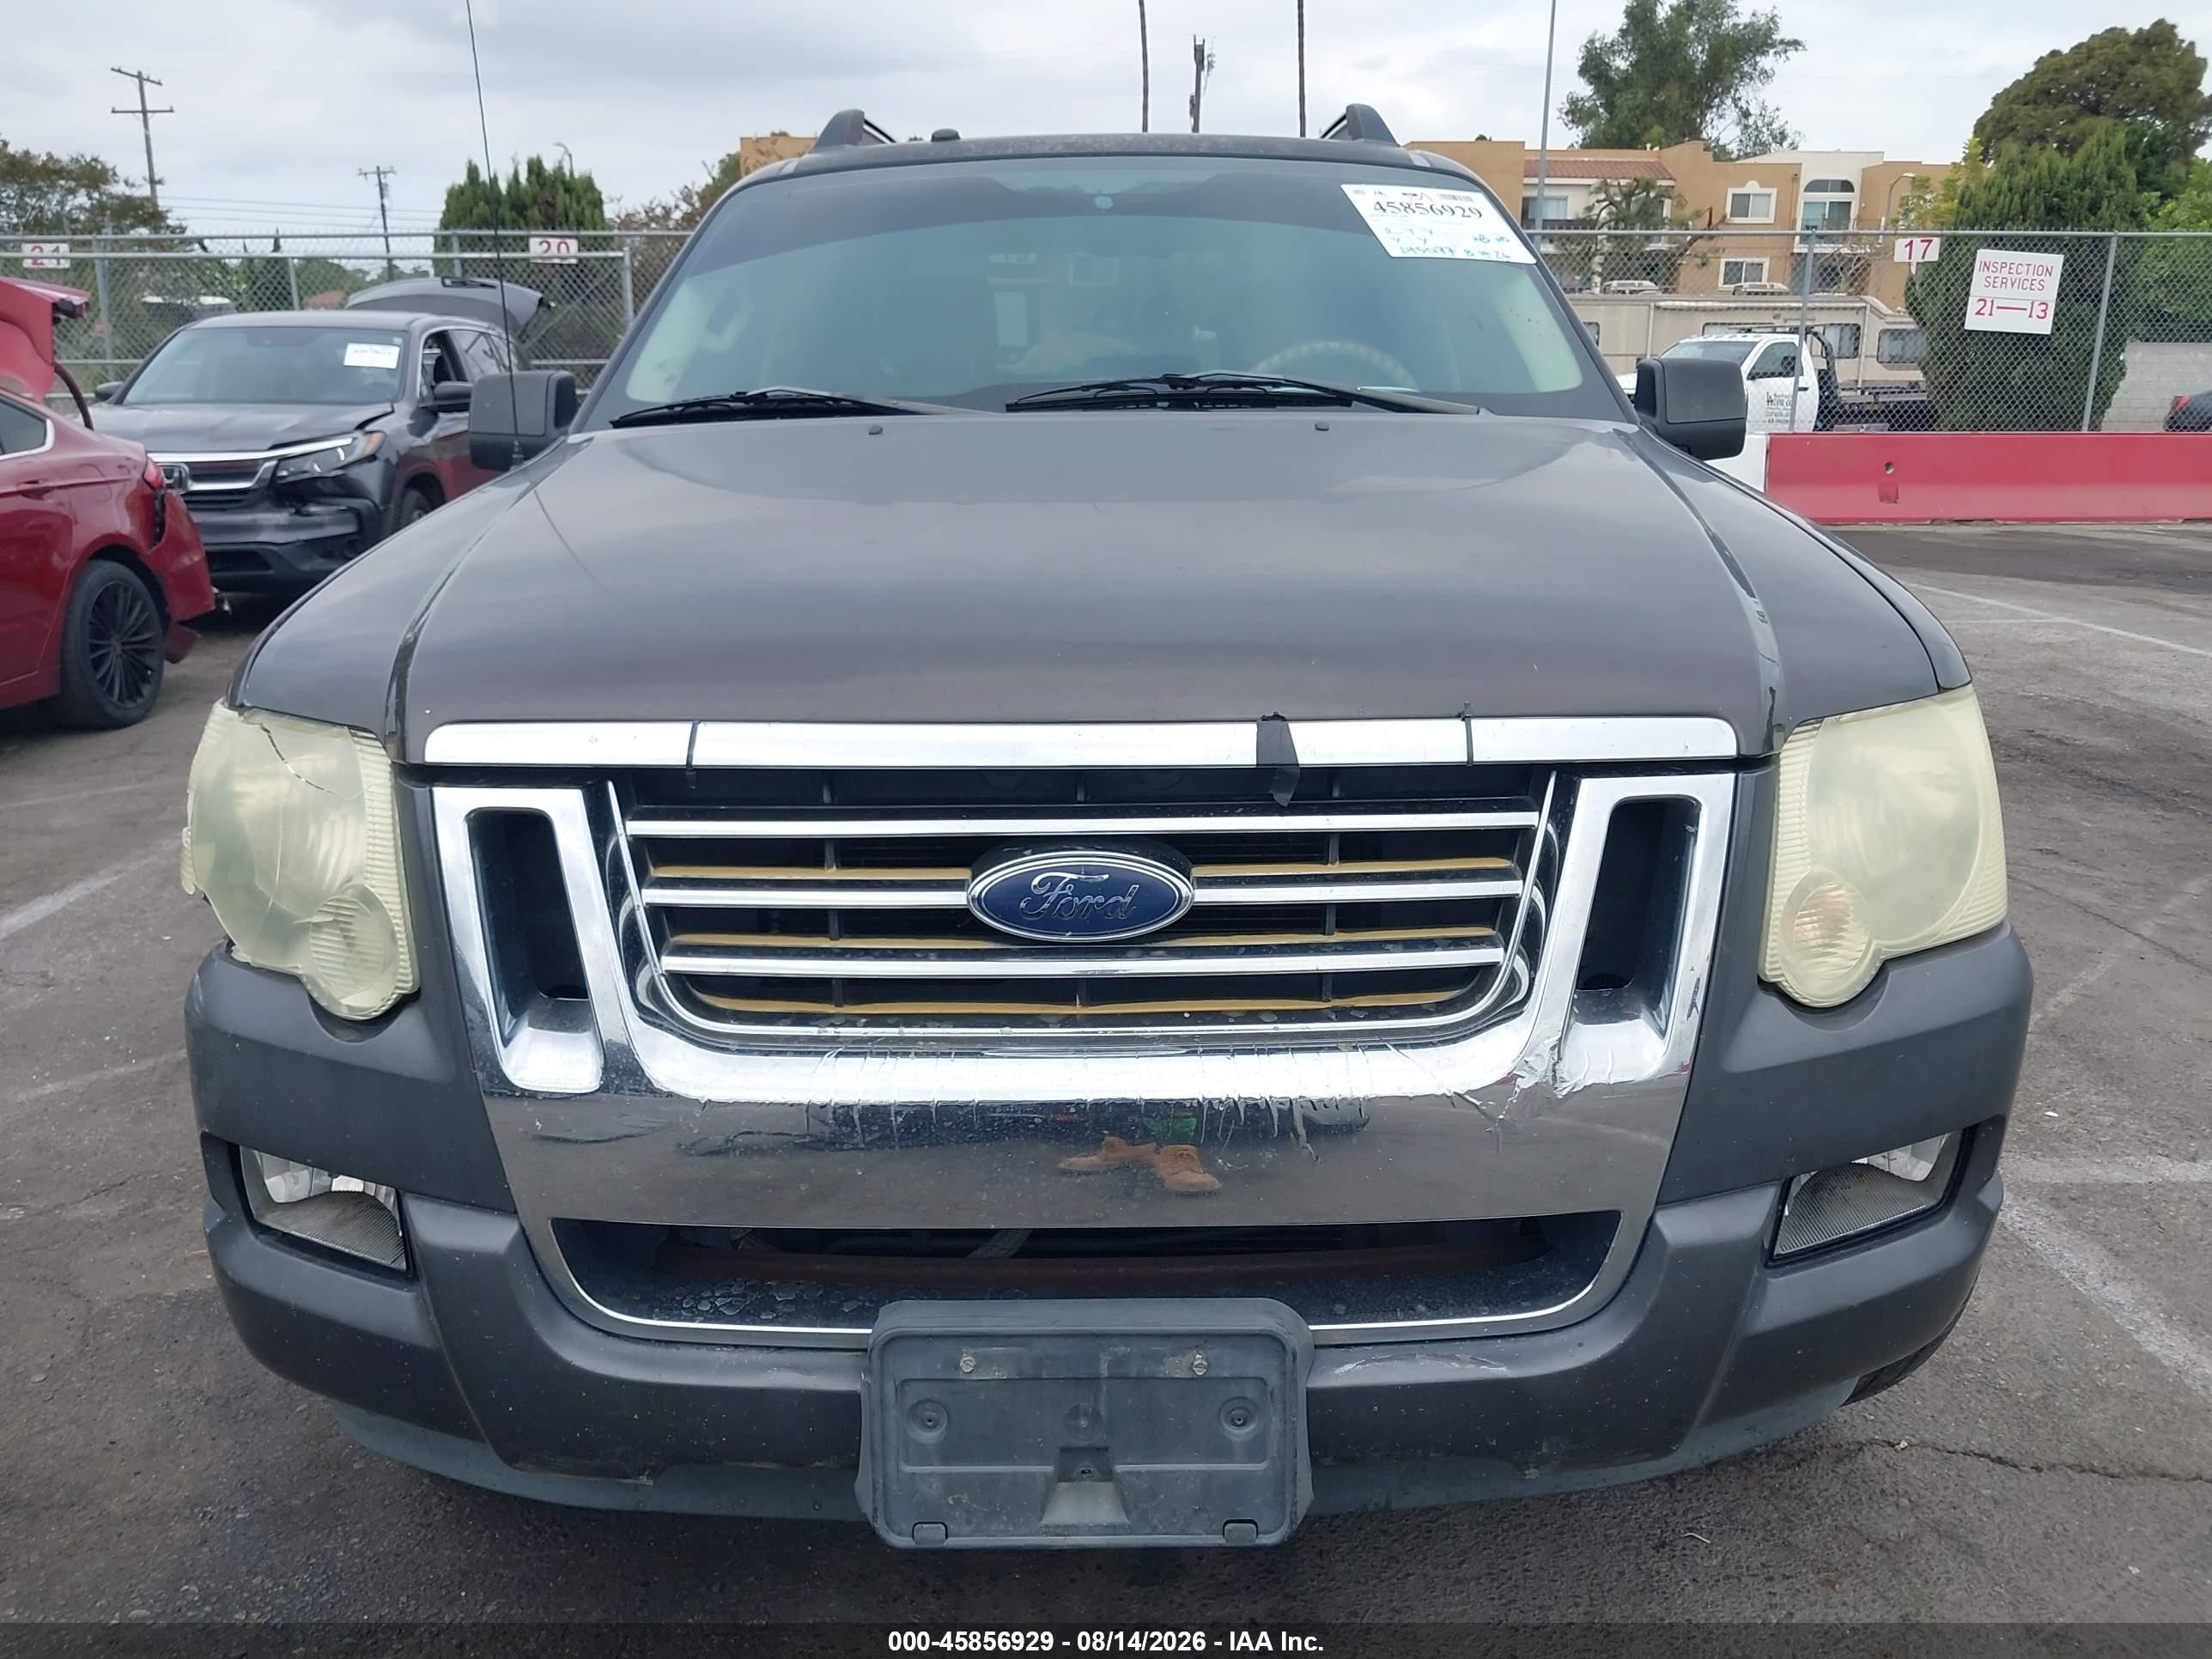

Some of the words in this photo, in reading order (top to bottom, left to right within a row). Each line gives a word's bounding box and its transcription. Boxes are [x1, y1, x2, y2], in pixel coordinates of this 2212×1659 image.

[1373, 201, 1483, 219] 45856929
[1904, 239, 1934, 260] 17
[1978, 260, 2054, 277] INSPECTION
[1984, 276, 2045, 292] SERVICES
[1018, 870, 1140, 921] Ford
